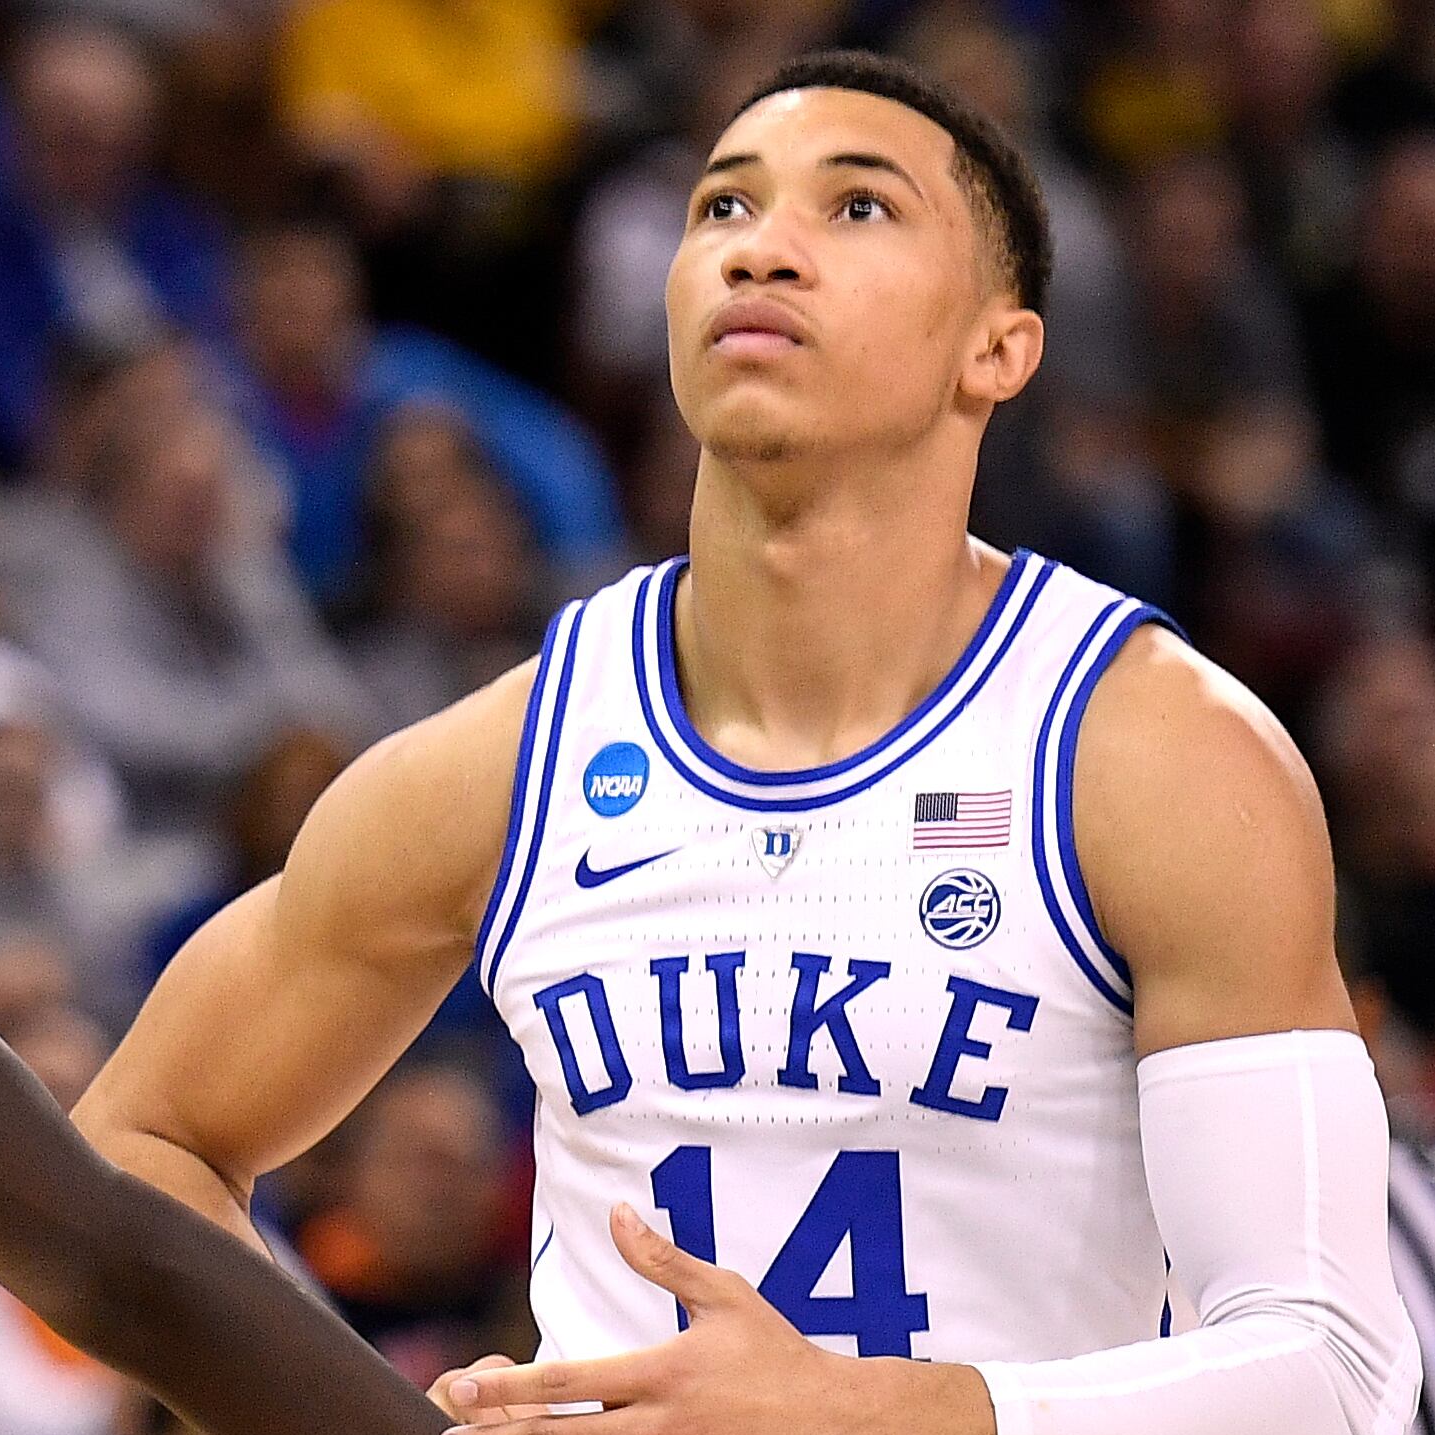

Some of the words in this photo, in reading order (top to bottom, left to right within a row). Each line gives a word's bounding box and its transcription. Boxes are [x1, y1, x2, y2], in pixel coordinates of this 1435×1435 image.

[590, 774, 643, 799] NCAA
[933, 892, 993, 918] ACC
[535, 951, 1039, 1121] DUKE
[651, 1145, 929, 1361] 14
